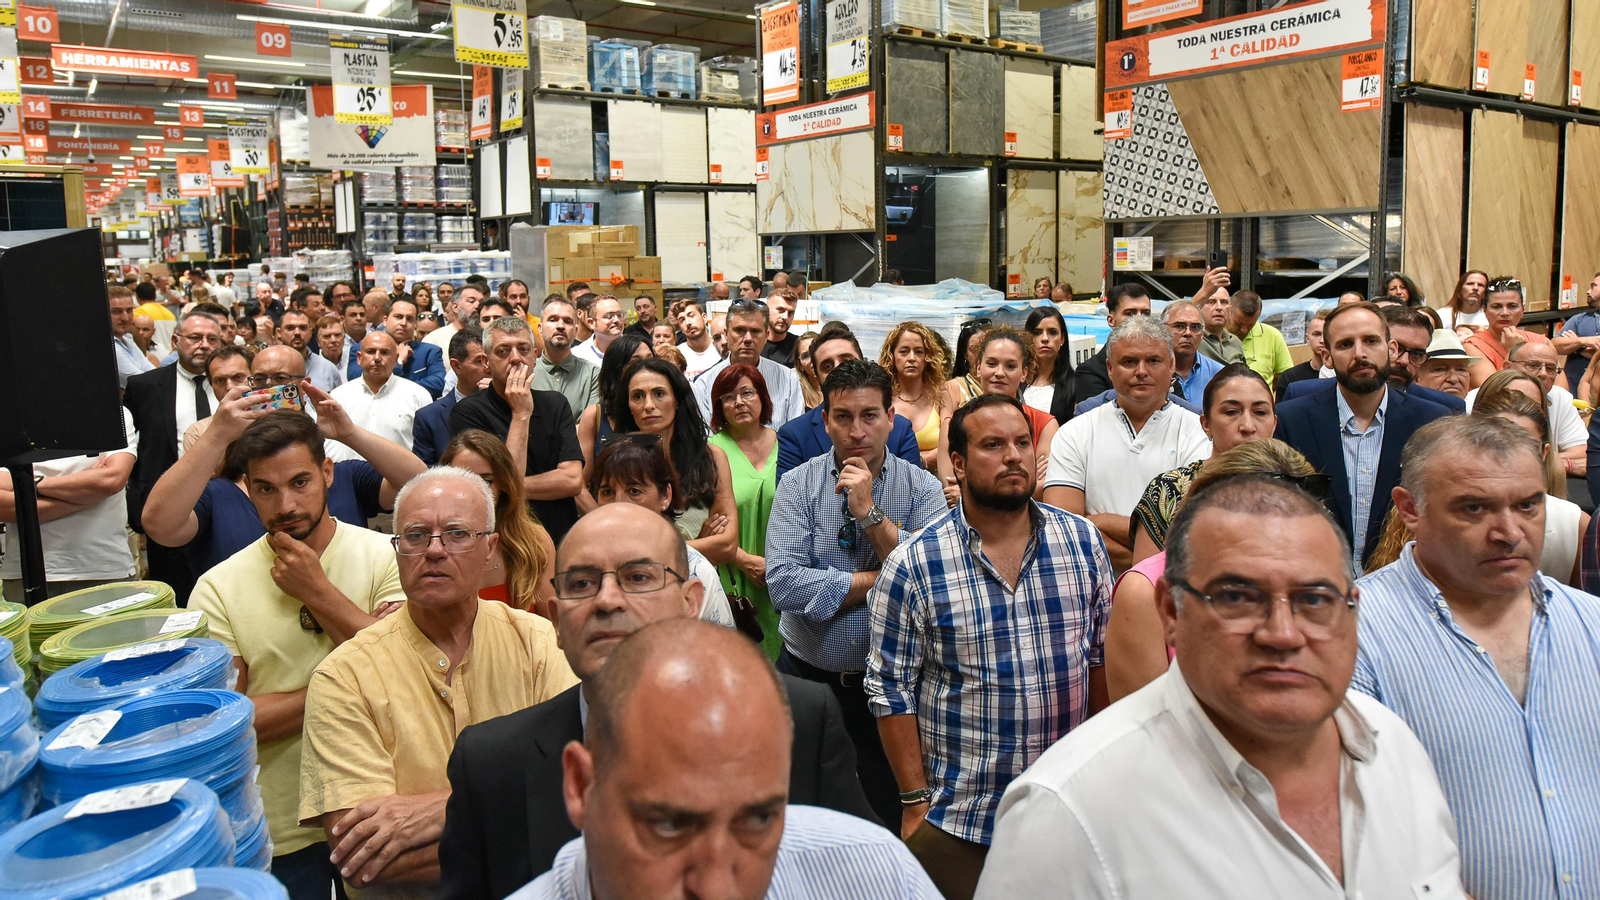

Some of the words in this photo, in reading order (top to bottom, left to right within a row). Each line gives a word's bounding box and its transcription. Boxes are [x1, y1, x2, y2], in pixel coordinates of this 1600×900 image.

[24, 15, 52, 34] 10
[493, 12, 507, 48] 5
[1177, 34, 1207, 49] TODA
[1210, 22, 1266, 43] NUESTRA
[1270, 8, 1342, 32] CERÁMICA
[260, 31, 287, 49] 09
[1229, 33, 1301, 58] CALIDAD
[61, 52, 191, 73] HERRAMIENTAS
[26, 64, 48, 79] 12
[213, 80, 230, 94] 11
[28, 101, 45, 113] 14
[60, 108, 142, 121] FERRETERÍA
[183, 110, 200, 122] 13
[788, 113, 801, 122] TODA
[802, 109, 827, 120] NUESTRA
[28, 120, 45, 131] 16
[811, 117, 842, 130] CALIDAD
[166, 128, 181, 138] 15
[28, 138, 44, 148] 18
[57, 141, 119, 150] FONTANERÍA
[148, 145, 161, 155] 17
[387, 152, 419, 160] disponibles
[30, 155, 44, 164] 20
[136, 158, 148, 167] 19
[372, 158, 404, 166] profesional
[126, 169, 137, 177] 21
